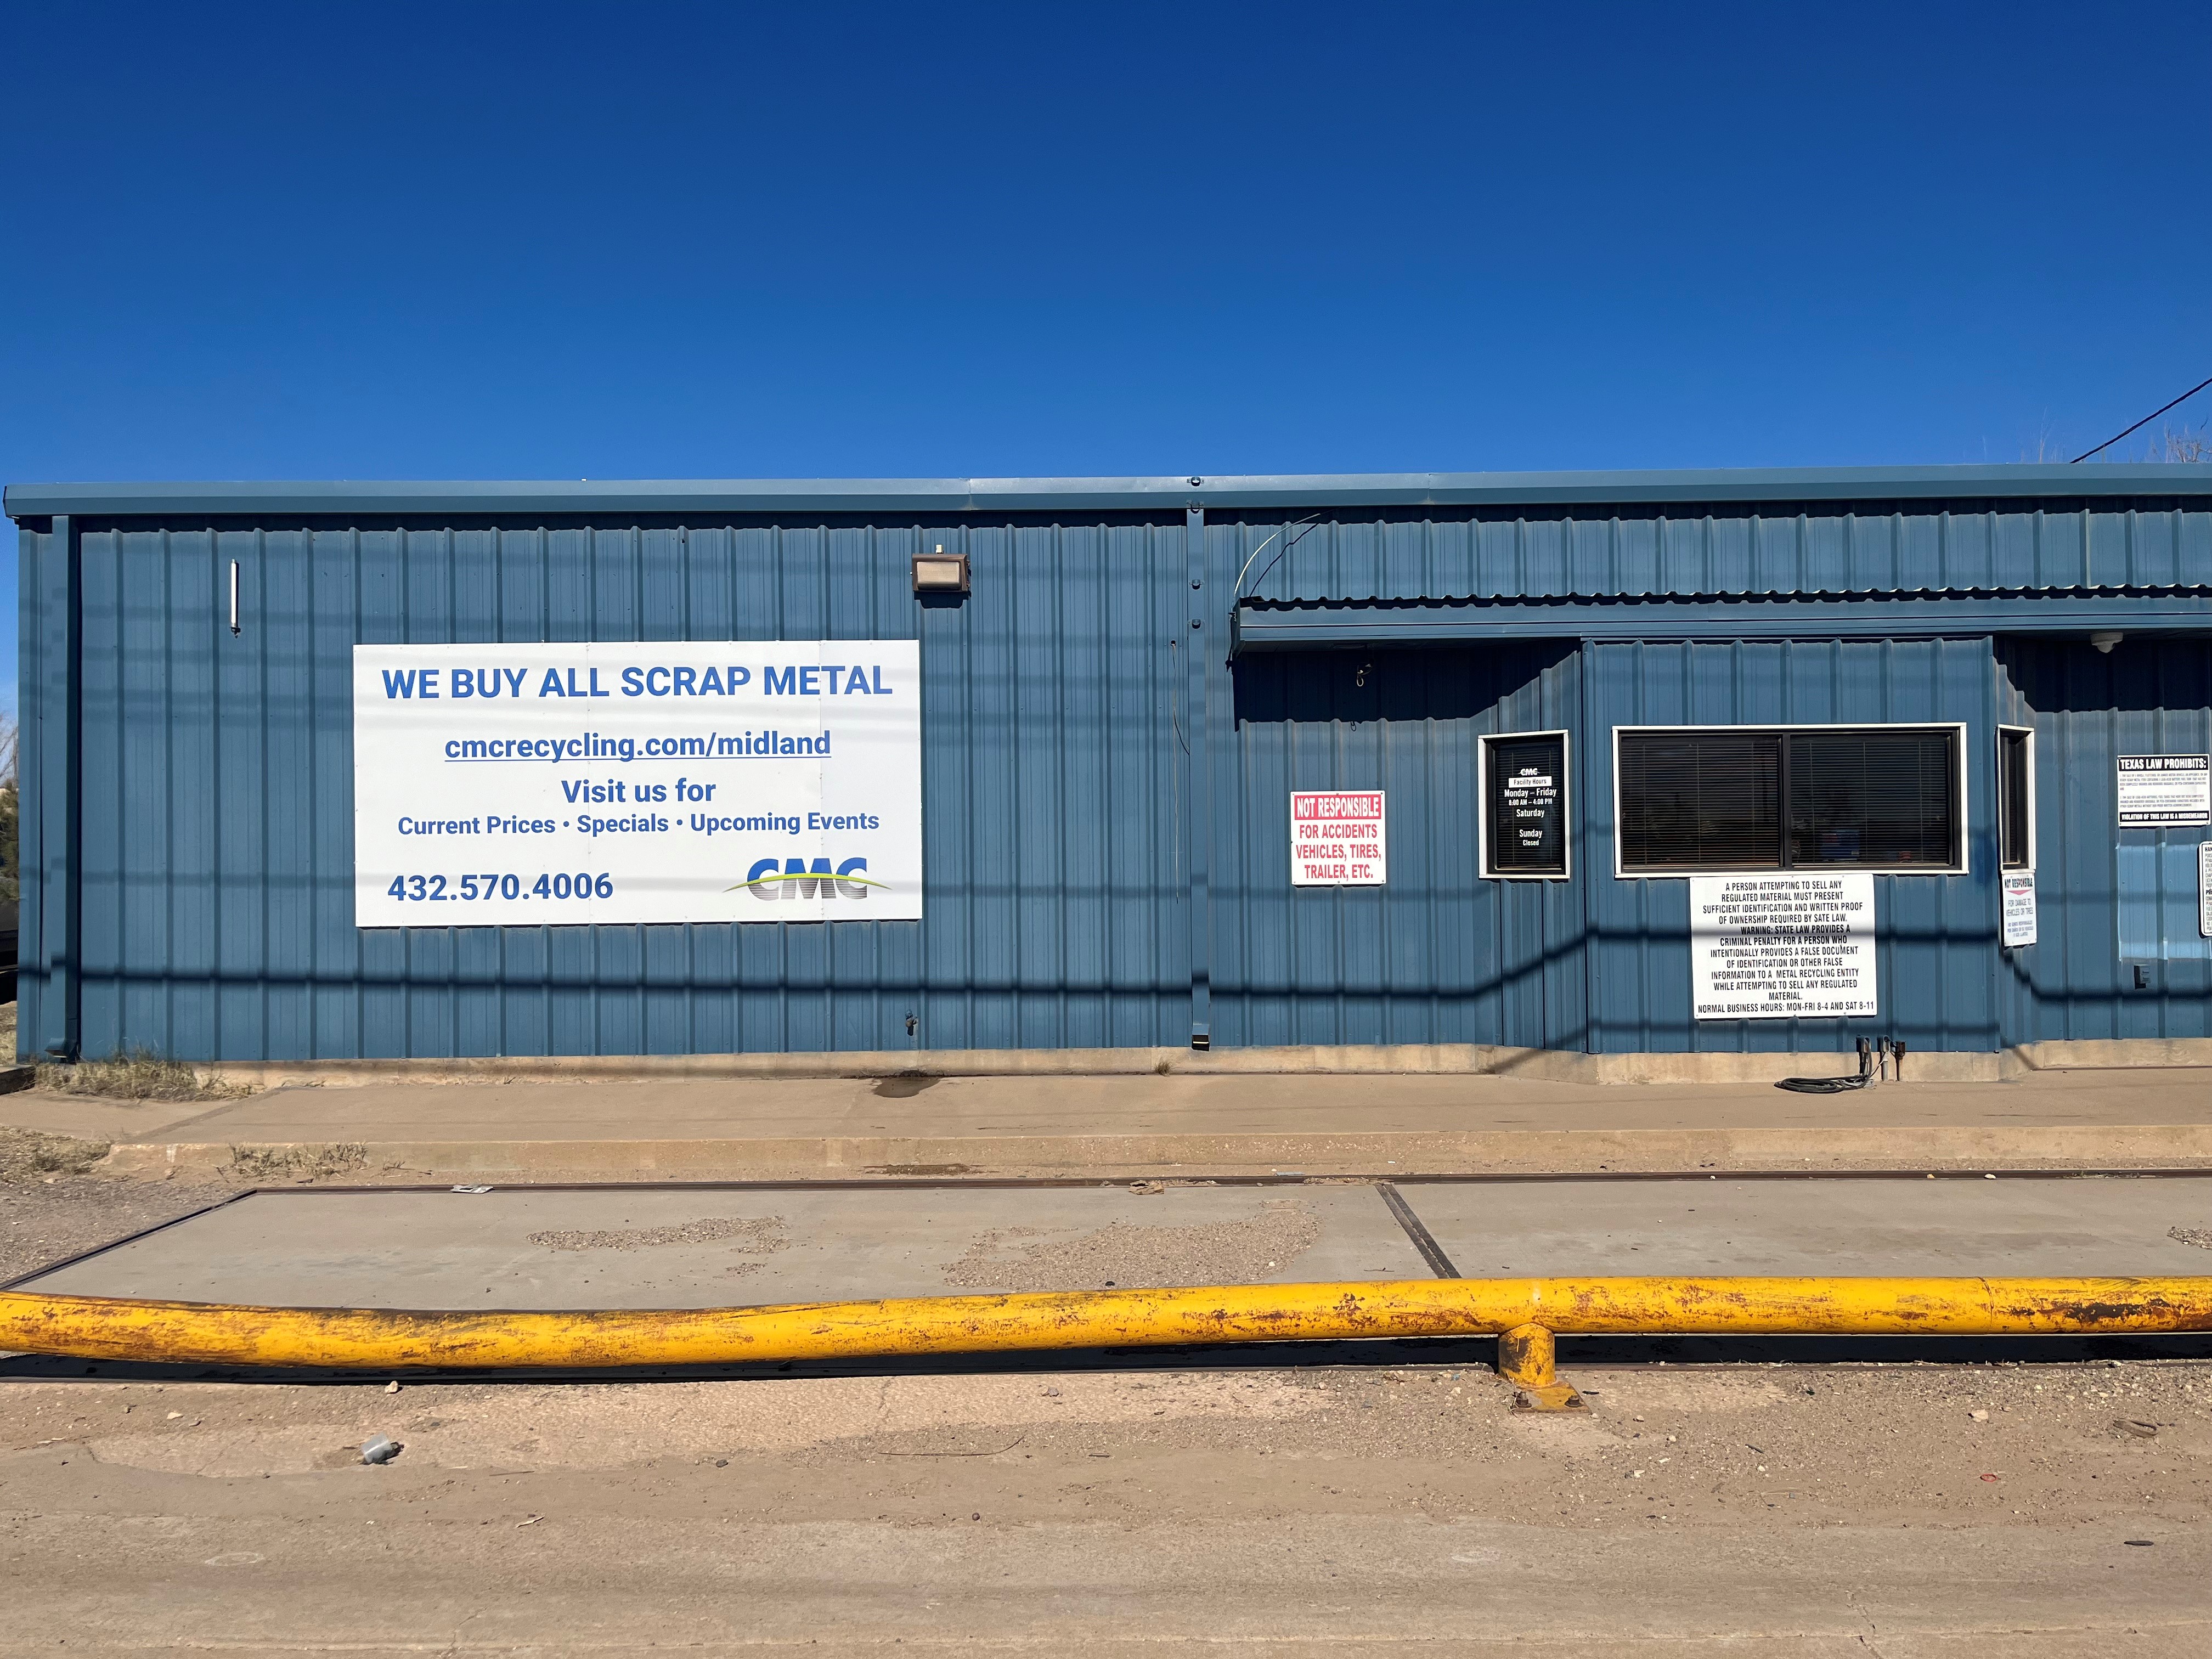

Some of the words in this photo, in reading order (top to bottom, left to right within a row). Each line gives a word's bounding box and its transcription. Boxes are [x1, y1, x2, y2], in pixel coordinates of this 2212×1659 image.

[383, 670, 439, 698] WE
[452, 669, 527, 697] BUY
[540, 668, 609, 697] ALL
[622, 667, 750, 696] SCRAP
[765, 666, 891, 695] METAL
[446, 731, 830, 762] cmcrecycling.com/midland
[2120, 759, 2143, 769] TEXAS
[2146, 759, 2162, 769] LAW
[2164, 758, 2207, 769] PROHIBITS:
[562, 779, 625, 802] Visit
[635, 785, 666, 802] us
[676, 778, 715, 801] for
[1504, 789, 1528, 798] Monday
[1537, 788, 1556, 797] Friday
[1297, 798, 1315, 817] NOT
[1318, 797, 1379, 817] RESPONSIBLE
[1516, 809, 1544, 817] Saturday
[399, 817, 479, 834] Current
[488, 816, 555, 833] Prices
[578, 814, 668, 836] Specials
[692, 812, 800, 835] Upcoming
[809, 813, 878, 829] Events
[1300, 825, 1319, 838] FOR
[1322, 824, 1377, 838] ACCIDENTS
[1520, 829, 1542, 838] Sunday
[1296, 844, 1347, 861] VEHICLES,
[1350, 844, 1381, 861] TIRES,
[746, 857, 867, 900] CMC
[1305, 865, 1348, 882] TRAILER,
[1352, 864, 1373, 878] ETC.
[388, 873, 612, 900] 432.570.4006
[1760, 882, 1799, 890] ATTEMPTING
[1802, 881, 1809, 889] TO
[1722, 894, 1757, 902] REGULATED
[1760, 893, 1791, 901] MATERIAL
[1794, 892, 1812, 900] MUST
[1815, 891, 1843, 900] PRESENT
[1703, 905, 1740, 913] SUFFICIENT
[1743, 904, 1792, 912] IDENTIFICATION
[1730, 915, 1767, 924] OWNERSHIP
[1770, 915, 1801, 923] REQUIRED
[1814, 914, 1829, 922] SATE
[1832, 913, 1847, 922] LAW.
[1741, 926, 1773, 935] WARNING:
[1775, 926, 1793, 934] STATE
[1812, 924, 1844, 933] PROVIDES
[1846, 924, 1850, 933] A
[1720, 938, 1752, 946] CRIMINAL
[1754, 936, 1781, 945] PENALTY
[1783, 936, 1796, 945] FOR
[1804, 935, 1830, 944] PERSON
[1832, 935, 1847, 944] WHO
[1711, 949, 1758, 957] INTENTIONALLY
[1761, 947, 1792, 956] PROVIDES
[1801, 947, 1819, 955] FALSE
[1822, 945, 1858, 955] DOCUMENT
[1727, 960, 1734, 968] OF
[1737, 959, 1787, 968] IDENTIFICATION
[1712, 971, 1755, 979] INFORMATION
[1800, 969, 1835, 977] RECYCLING
[1736, 981, 1776, 990] ATTEMPTING
[1779, 981, 1786, 989] TO
[1821, 980, 1857, 988] REGULATED
[1769, 992, 1802, 1000] MATERIAL.
[1699, 1005, 1725, 1013] NORMAL
[1728, 1003, 1758, 1012] BUSINESS
[1760, 1003, 1784, 1011] HOURS:
